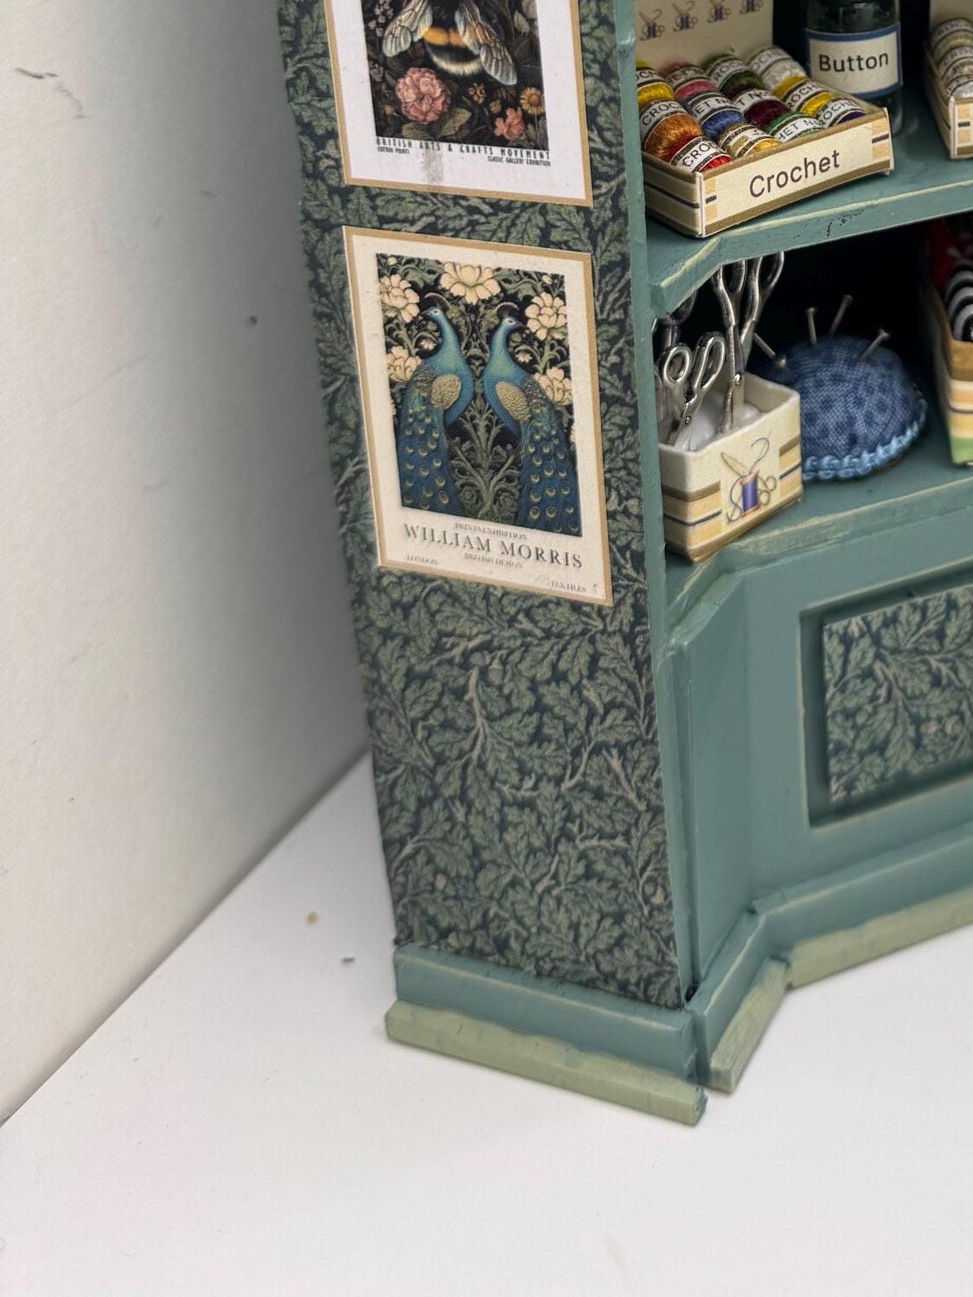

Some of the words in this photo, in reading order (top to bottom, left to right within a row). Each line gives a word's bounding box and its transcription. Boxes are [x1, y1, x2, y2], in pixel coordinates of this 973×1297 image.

[818, 52, 889, 72] Button
[376, 137, 412, 148] BRITISH
[419, 140, 441, 151] ARTS
[459, 143, 494, 155] CRAFTS
[500, 148, 551, 160] MOVEMENT
[749, 149, 841, 198] Crochet
[404, 523, 491, 552] WILLIAM
[501, 540, 583, 569] MORRIS
